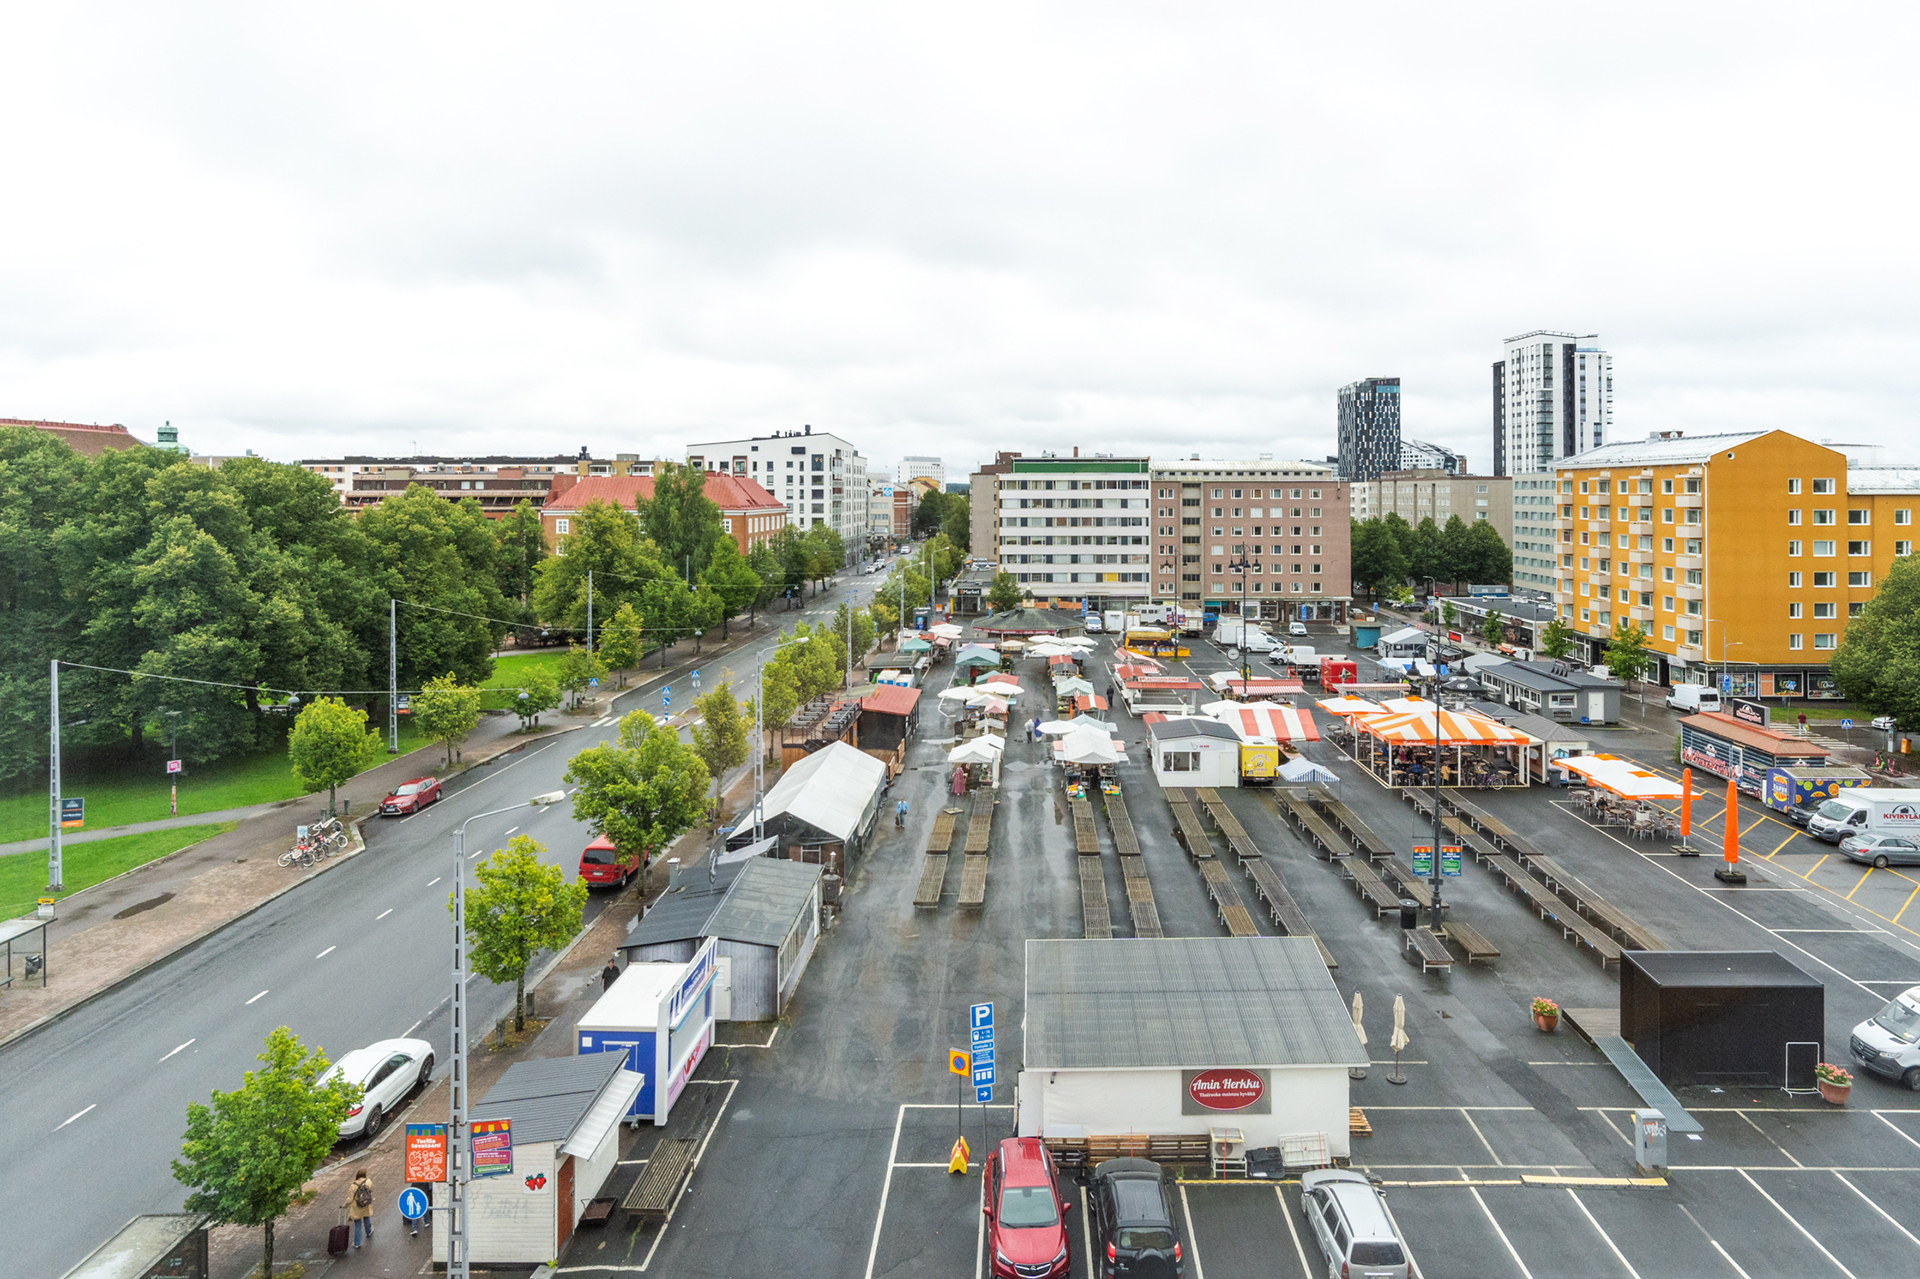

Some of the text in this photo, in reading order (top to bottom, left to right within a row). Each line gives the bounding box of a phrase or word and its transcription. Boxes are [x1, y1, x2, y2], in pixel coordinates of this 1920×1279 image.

[975, 1005, 990, 1027] P
[1192, 1078, 1261, 1091] Amin Herkku
